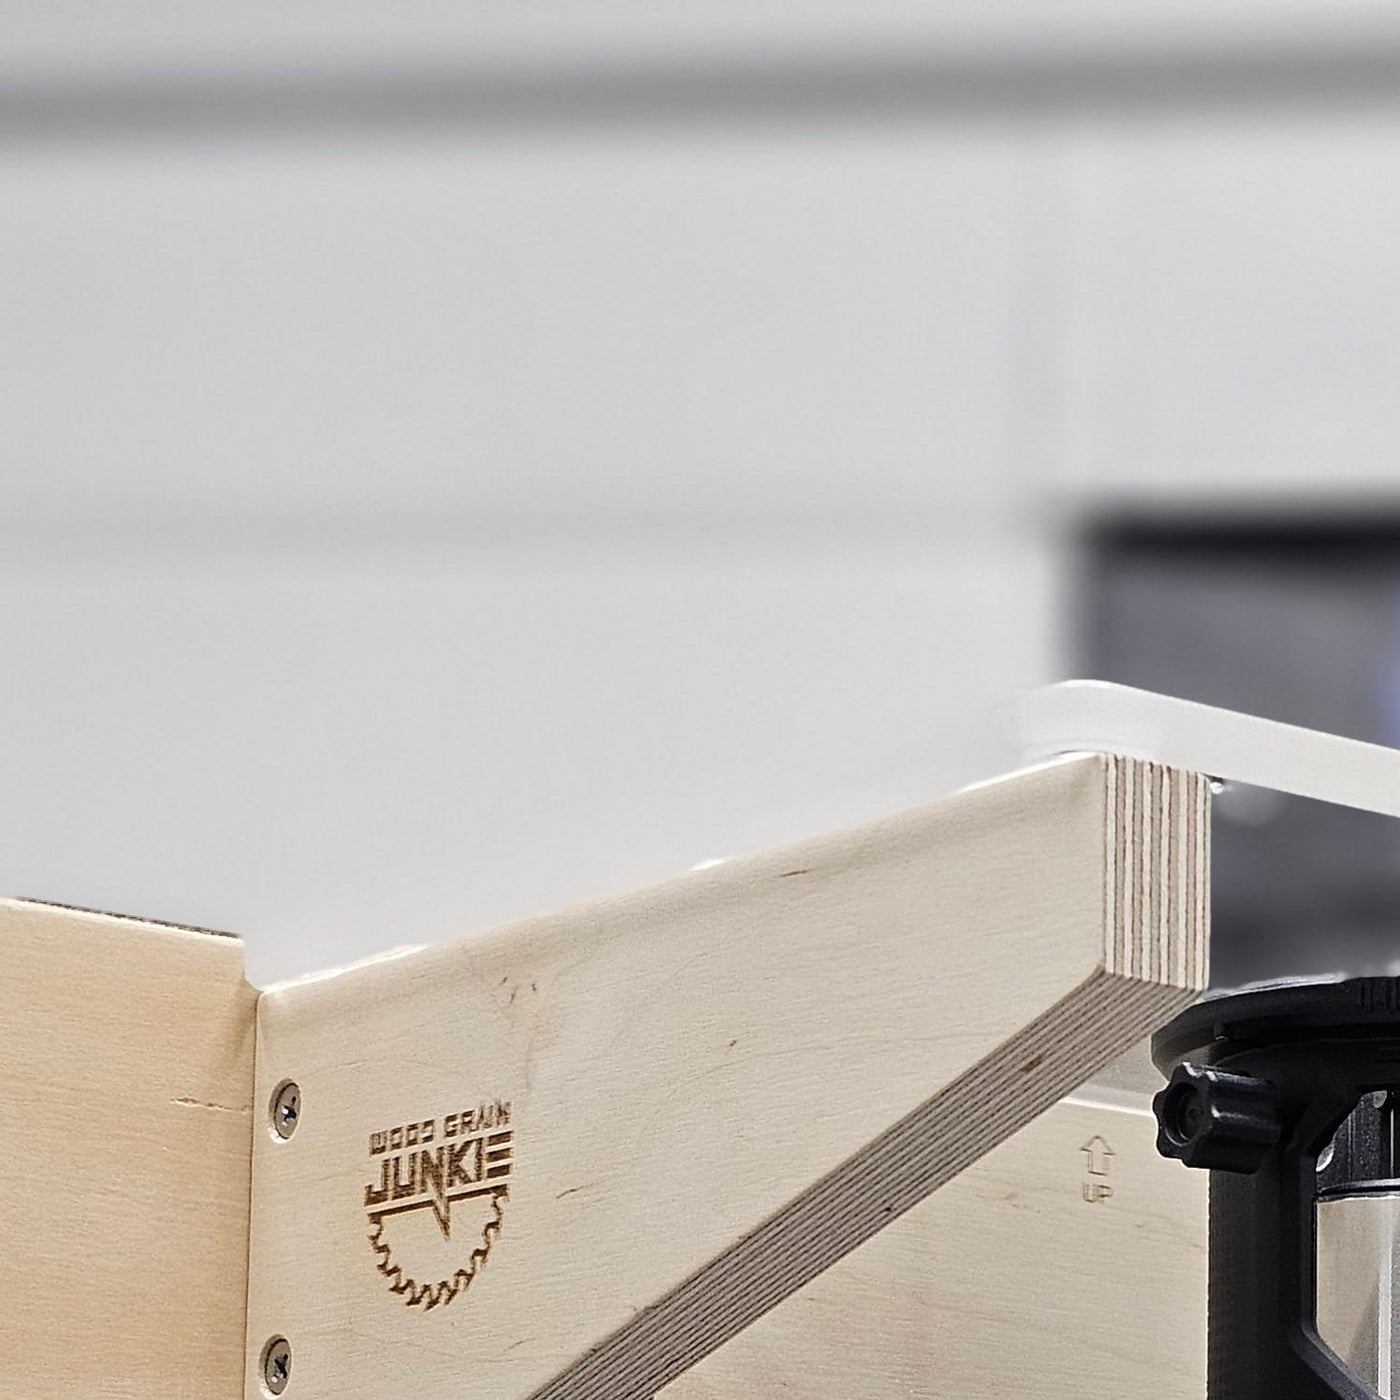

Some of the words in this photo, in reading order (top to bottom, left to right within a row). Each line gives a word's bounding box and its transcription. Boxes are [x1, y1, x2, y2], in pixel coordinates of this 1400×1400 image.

[369, 1119, 435, 1156] WOOD
[444, 1101, 512, 1138] GRAIN
[364, 1130, 514, 1207] JUNKIE
[1082, 1182, 1114, 1204] UP
